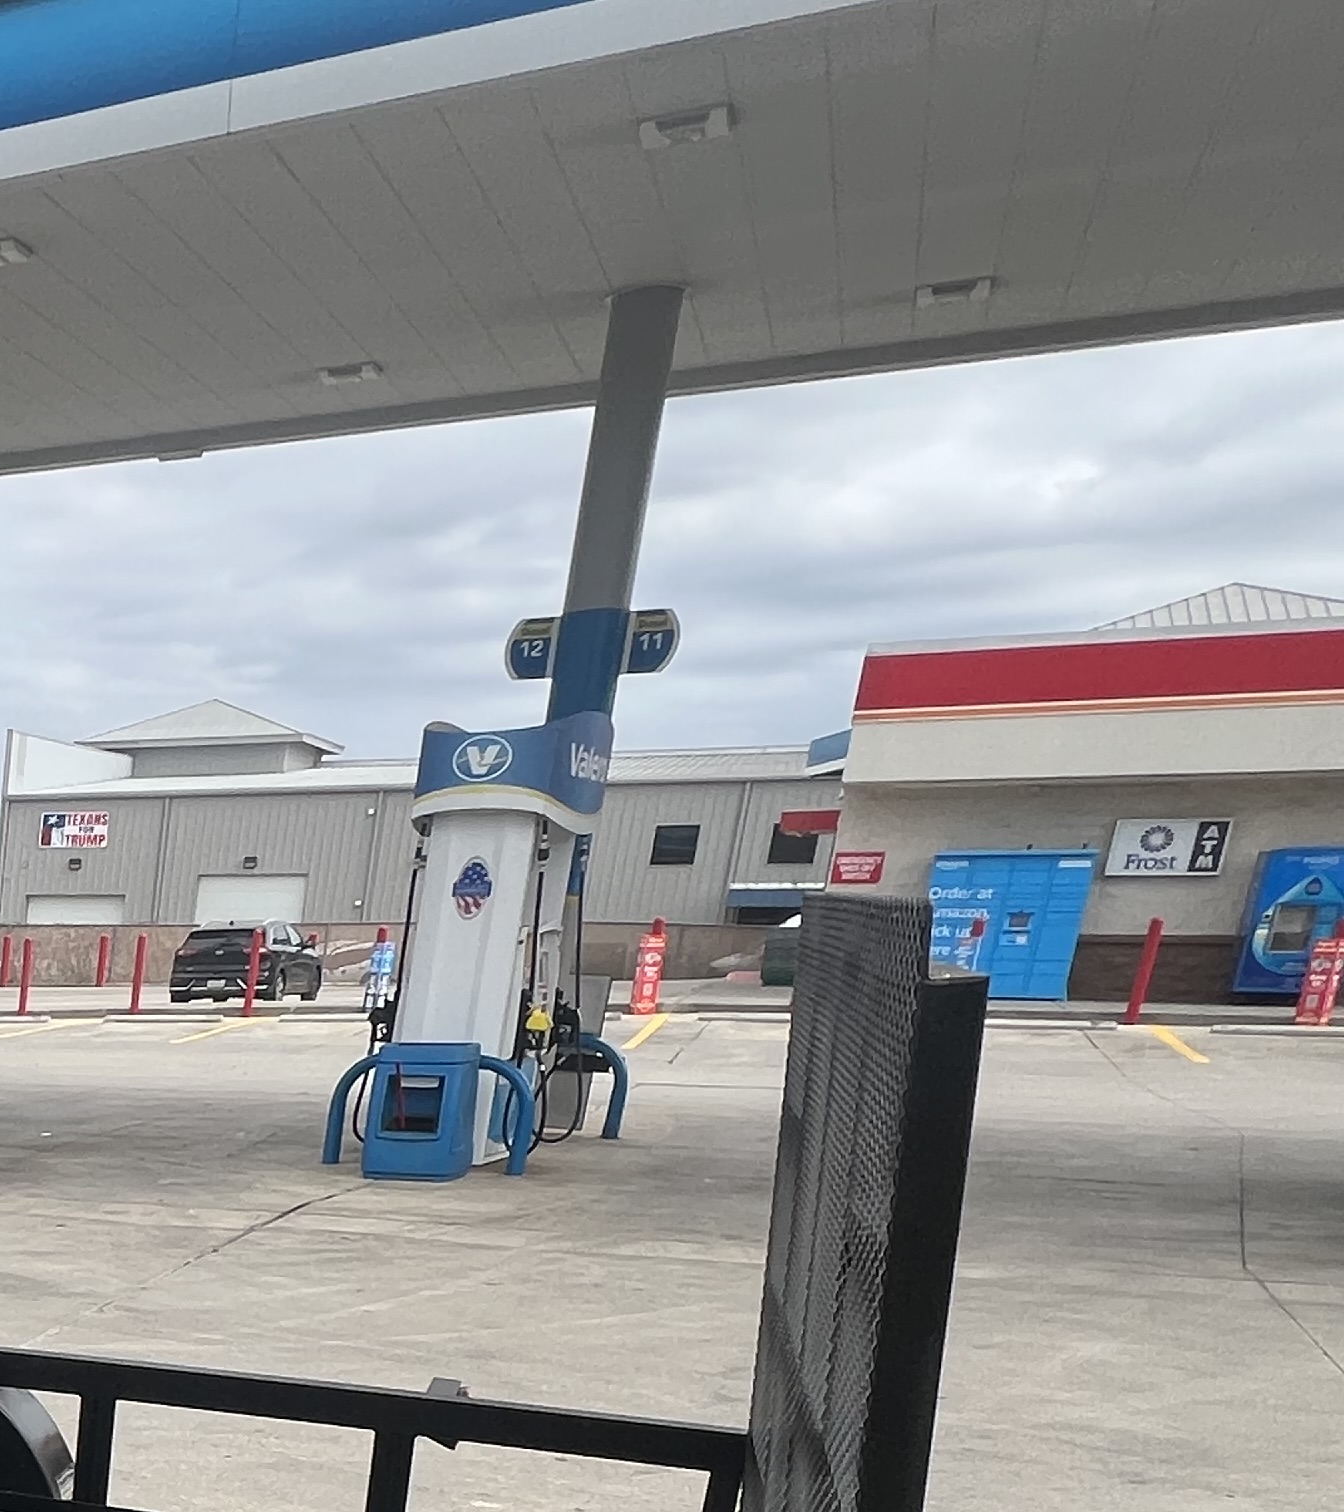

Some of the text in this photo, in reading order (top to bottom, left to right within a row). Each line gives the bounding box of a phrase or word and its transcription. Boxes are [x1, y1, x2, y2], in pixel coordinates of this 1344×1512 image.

[520, 640, 544, 658] 12
[639, 633, 664, 651] 11
[67, 813, 108, 826] TEXANS
[65, 834, 106, 848] TRUMP
[1194, 824, 1220, 869] ATM
[1123, 853, 1178, 870] Frost
[928, 886, 994, 900] Order at
[930, 924, 952, 938] ick
